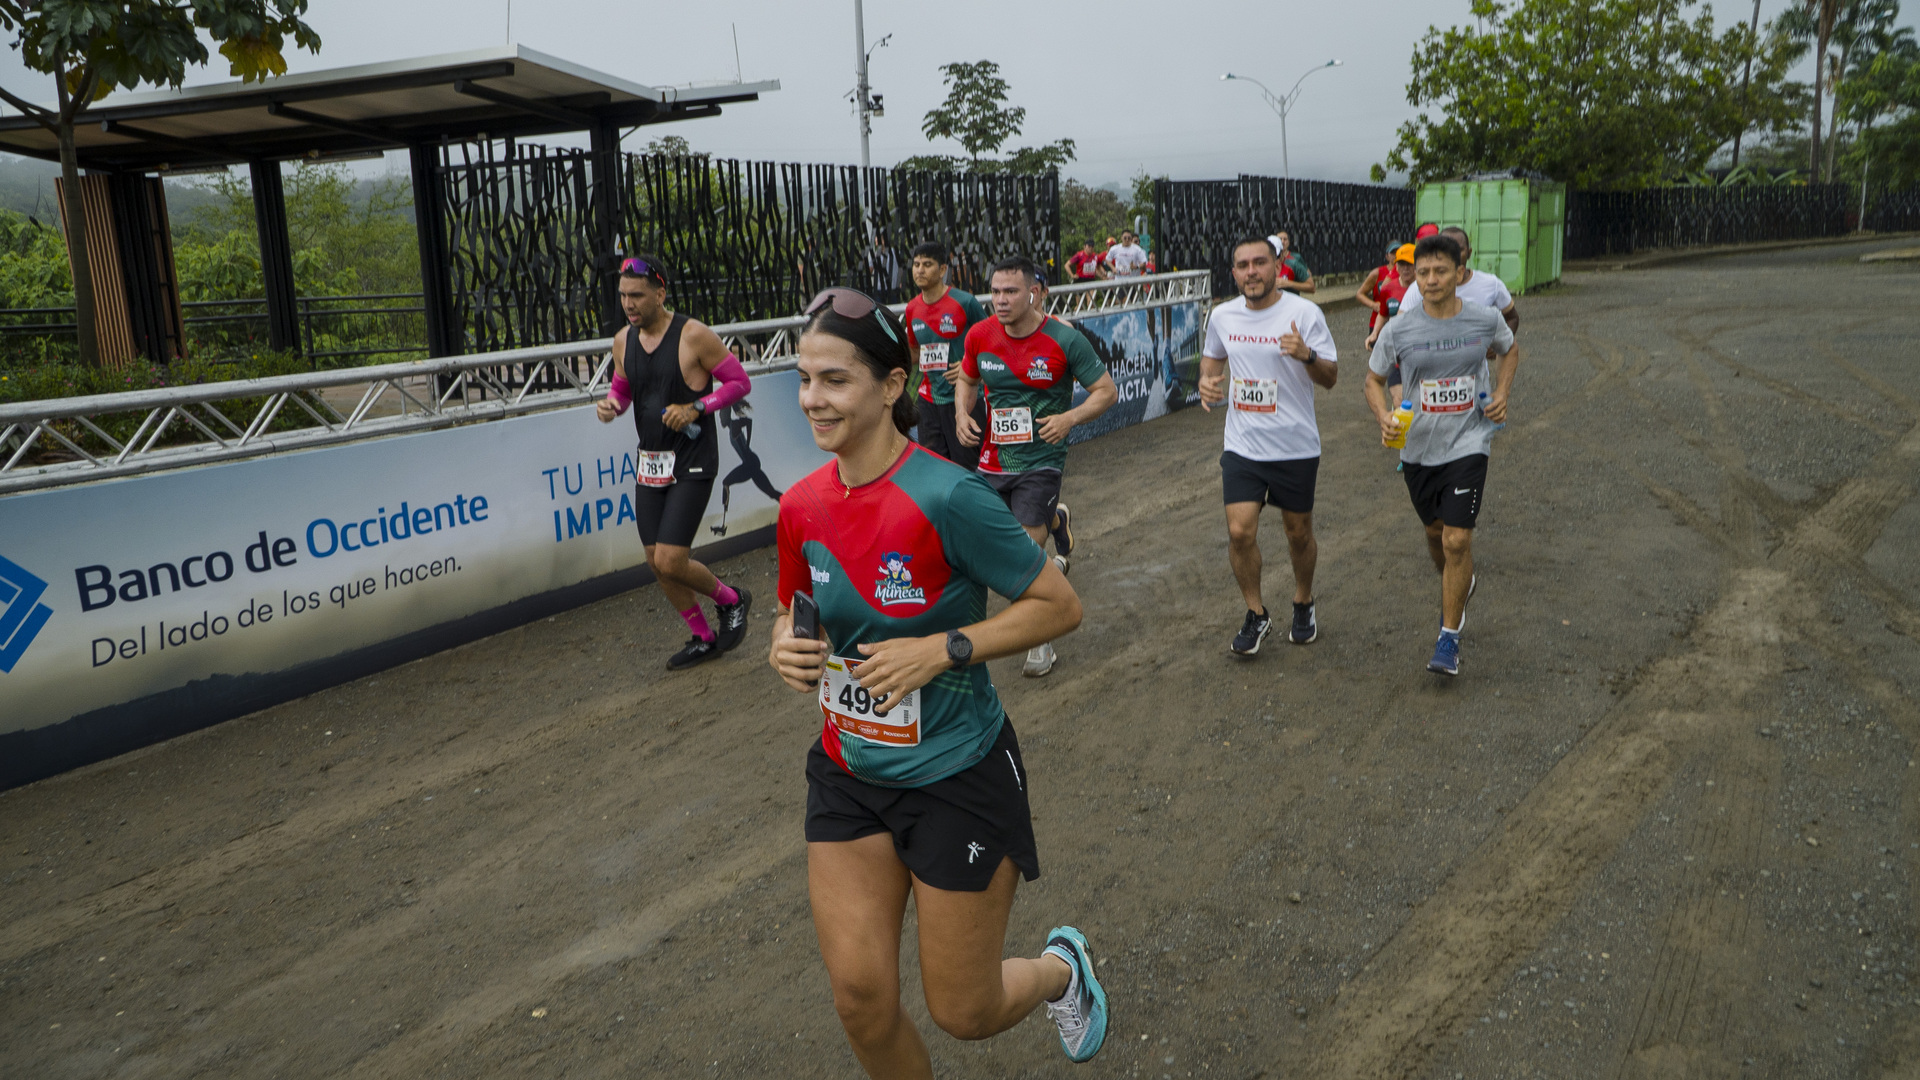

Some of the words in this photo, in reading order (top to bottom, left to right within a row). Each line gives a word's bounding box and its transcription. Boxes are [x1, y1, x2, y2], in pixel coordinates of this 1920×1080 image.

[1229, 334, 1278, 345] HONDA
[924, 352, 943, 362] 794
[1115, 377, 1151, 404] ACTA.
[1241, 389, 1264, 403] 340
[1430, 388, 1467, 403] 1595
[646, 462, 664, 475] 781
[542, 463, 583, 500] TU
[74, 550, 235, 613] Banco
[245, 530, 298, 574] de
[305, 493, 489, 559] Occidente
[91, 625, 148, 668] Del
[159, 611, 230, 651] lado
[237, 597, 274, 629] de
[282, 589, 321, 618] los
[328, 576, 377, 609] que
[385, 552, 463, 590] hacen.
